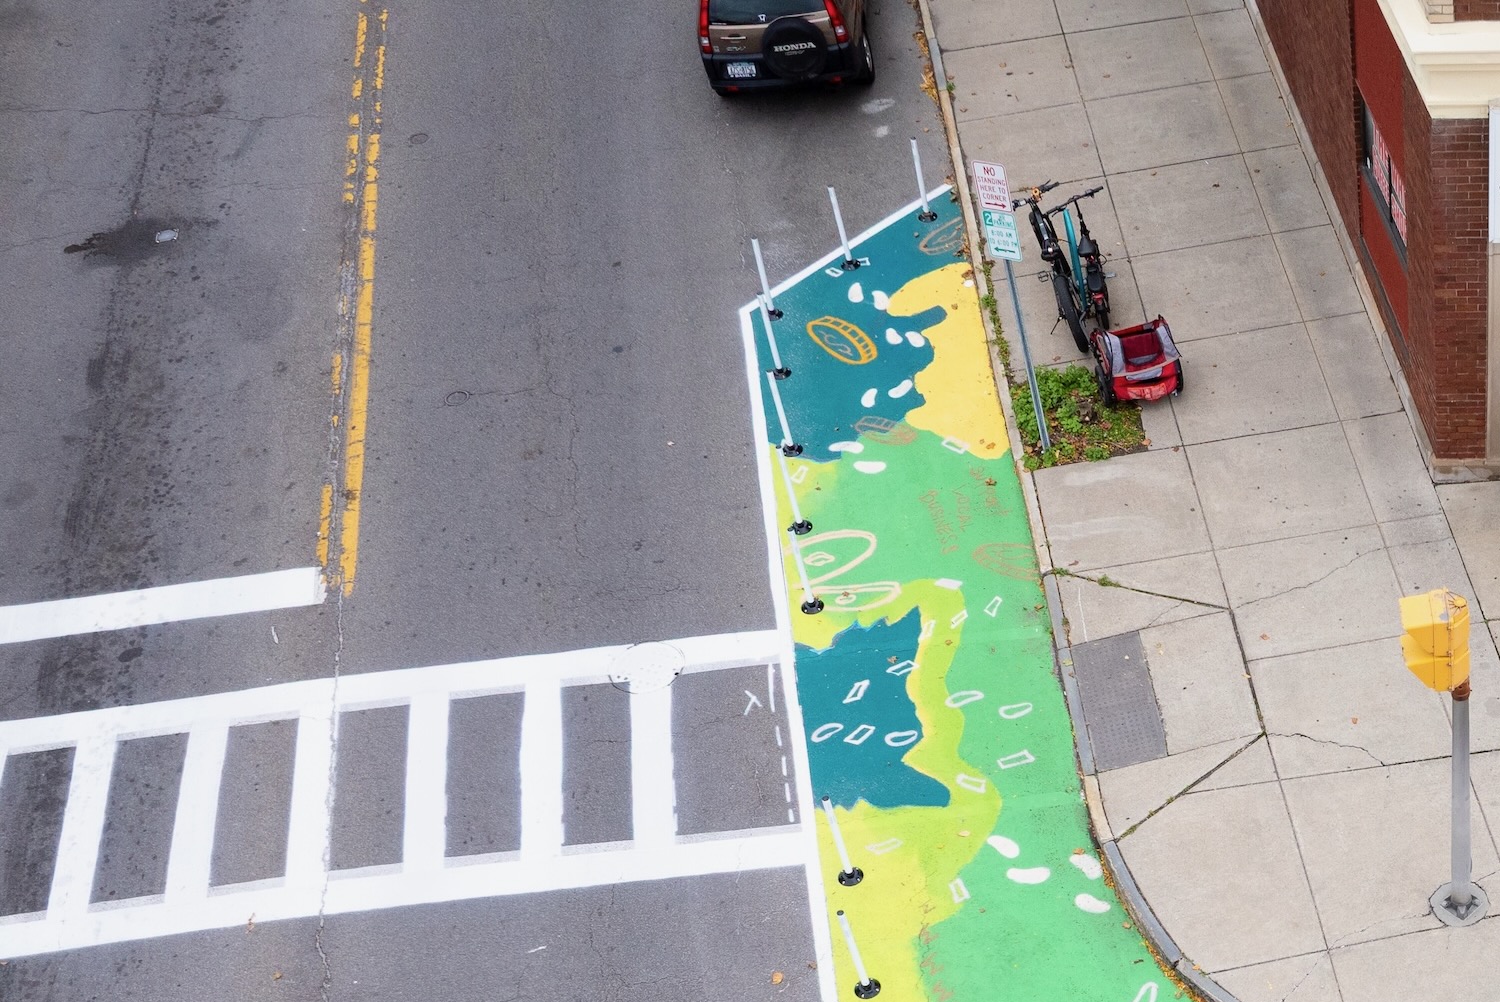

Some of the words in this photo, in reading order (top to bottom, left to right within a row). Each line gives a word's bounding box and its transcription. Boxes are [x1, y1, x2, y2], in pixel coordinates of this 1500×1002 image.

[773, 42, 816, 52] HONDA
[983, 166, 996, 177] NO
[978, 176, 1006, 187] STANDING
[980, 184, 996, 193] HERE
[998, 187, 1006, 195] TO
[983, 192, 1007, 202] CORNER
[984, 212, 993, 225] 2
